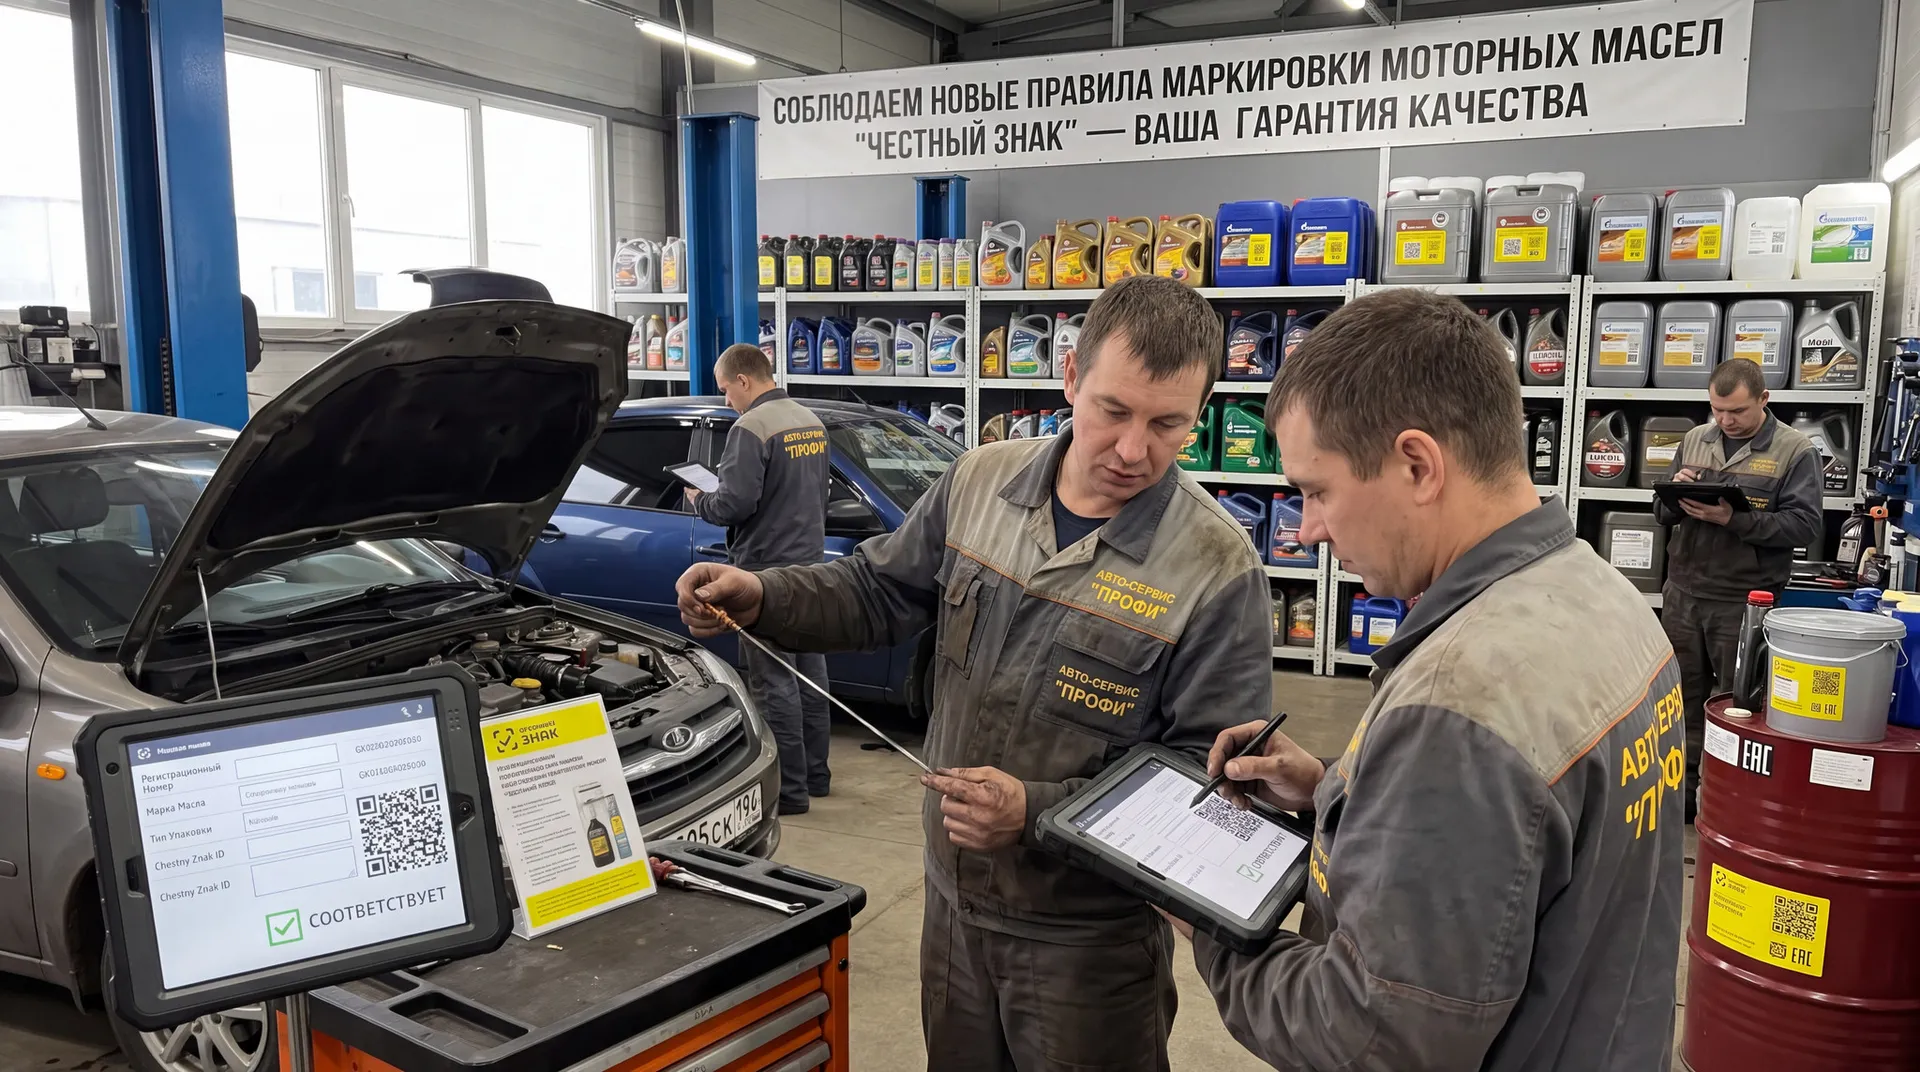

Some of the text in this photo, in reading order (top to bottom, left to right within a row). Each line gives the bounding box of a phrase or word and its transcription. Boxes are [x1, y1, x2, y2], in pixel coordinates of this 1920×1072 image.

[773, 18, 1723, 125] СОБЛЮДАЕМ НОВЫЕ ПРАВИЛА МАРКИРОВКИ МОТОРНЫХ МАСЕЛ
[855, 119, 986, 161] "ЧЕСТНЫЙ
[994, 119, 1077, 154] ЗНАК"
[1134, 110, 1219, 146] ВАША
[1236, 96, 1397, 141] ГАРАНТИЯ
[1409, 82, 1588, 128] КАЧЕСТВА
[1590, 453, 1622, 462] LUKOIL
[1095, 569, 1176, 604] АВТО-СЕРВИС
[1091, 583, 1168, 620] "ПРОФИ"
[1058, 664, 1140, 698] АВТО-СЕРВИС
[1055, 680, 1135, 717] "ПРОФИ"
[1824, 704, 1837, 715] EAC
[521, 728, 559, 746] ЗНАК
[1742, 739, 1773, 776] EAC
[141, 762, 221, 783] Регистрационный
[143, 783, 174, 794] Номер
[146, 799, 206, 817] Марка Масла
[150, 826, 213, 844] Тип Упаковки
[154, 850, 225, 872] Chestny Znak ID
[160, 880, 231, 903] Chestny Znak ID
[309, 886, 448, 930] СООТВЕТСТВУЕТ
[1791, 947, 1813, 967] EAC
